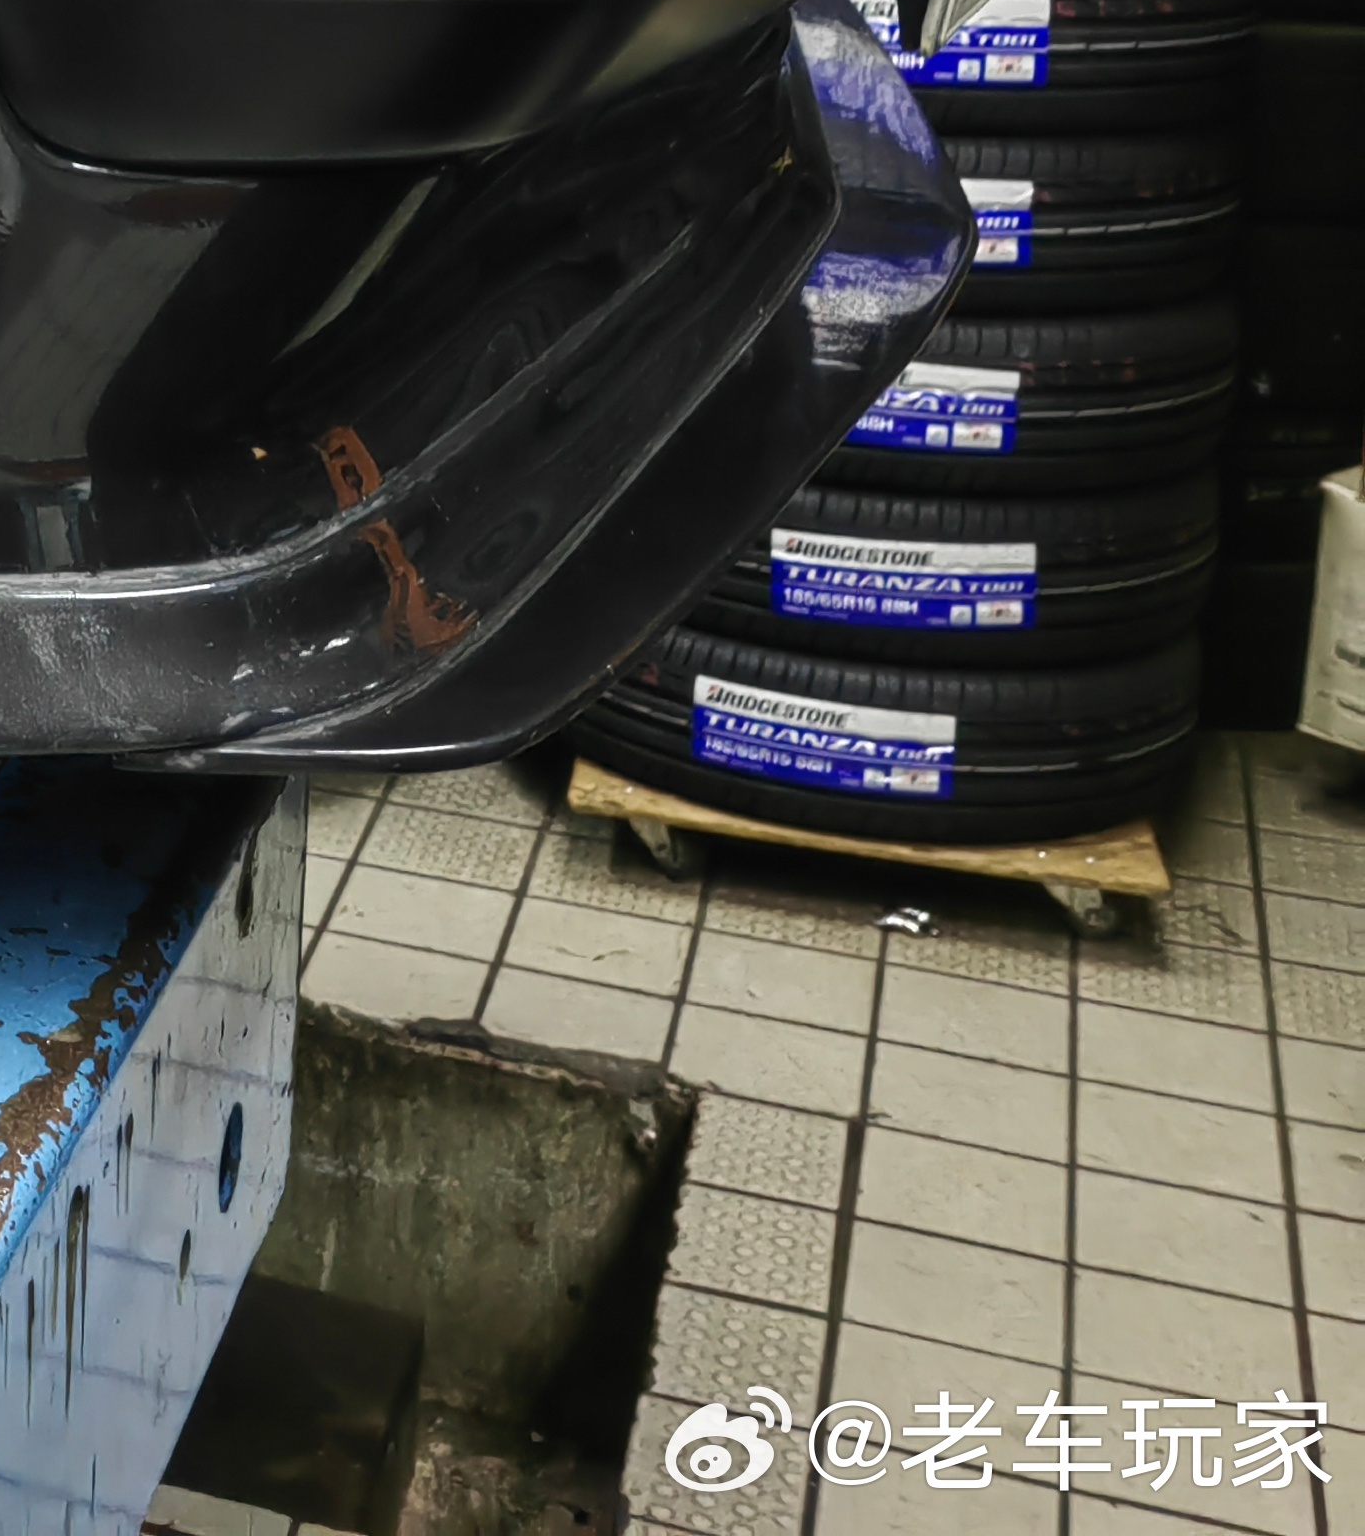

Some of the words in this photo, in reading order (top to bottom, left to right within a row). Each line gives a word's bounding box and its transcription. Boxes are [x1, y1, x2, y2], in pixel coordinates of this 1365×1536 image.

[784, 537, 936, 567] BRIDGESTONE
[784, 565, 964, 593] TURANZA
[705, 683, 856, 729] BRIDGESTONE
[703, 710, 878, 757] TURANZA
